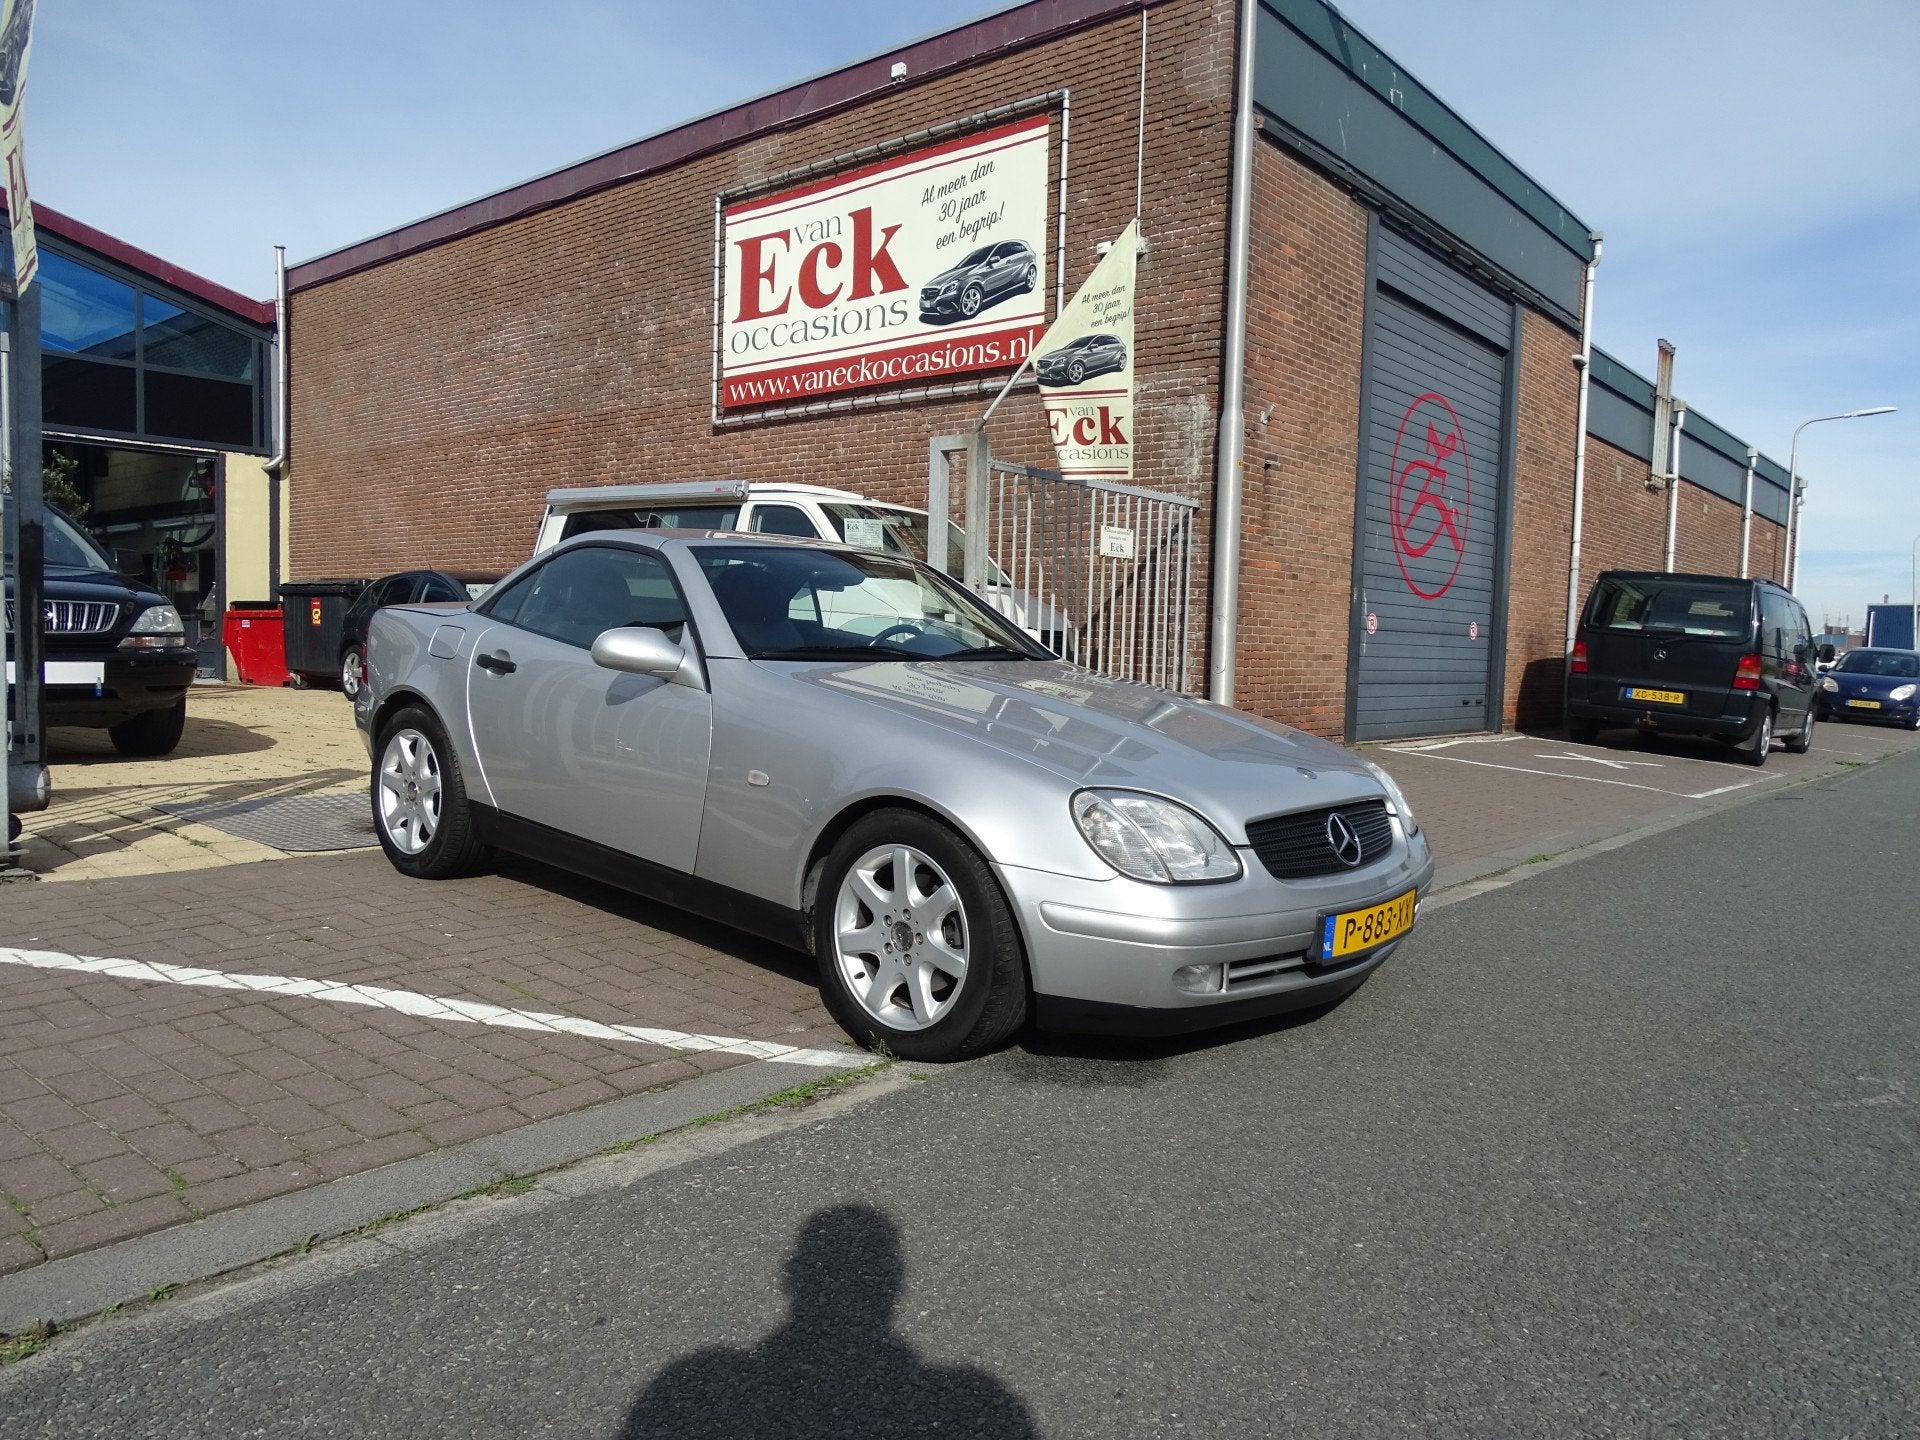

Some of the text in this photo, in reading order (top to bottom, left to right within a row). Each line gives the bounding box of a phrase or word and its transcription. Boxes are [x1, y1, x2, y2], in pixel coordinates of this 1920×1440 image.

[921, 160, 996, 207] Al meer dan
[938, 189, 988, 224] 30 jaar
[794, 215, 843, 245] van
[935, 200, 1005, 250] een begrip!
[731, 206, 910, 324] Eck
[1081, 284, 1126, 305] Al meer dan
[1092, 299, 1121, 316] 30 jaar
[731, 299, 909, 355] occasions
[1090, 306, 1131, 328] een begrip!
[729, 328, 1035, 402] www.vaneckoccasions.nl
[1044, 405, 1129, 446] Eck
[1069, 406, 1095, 416] van
[1110, 542, 1125, 553] Eck
[1323, 942, 1332, 952] NL
